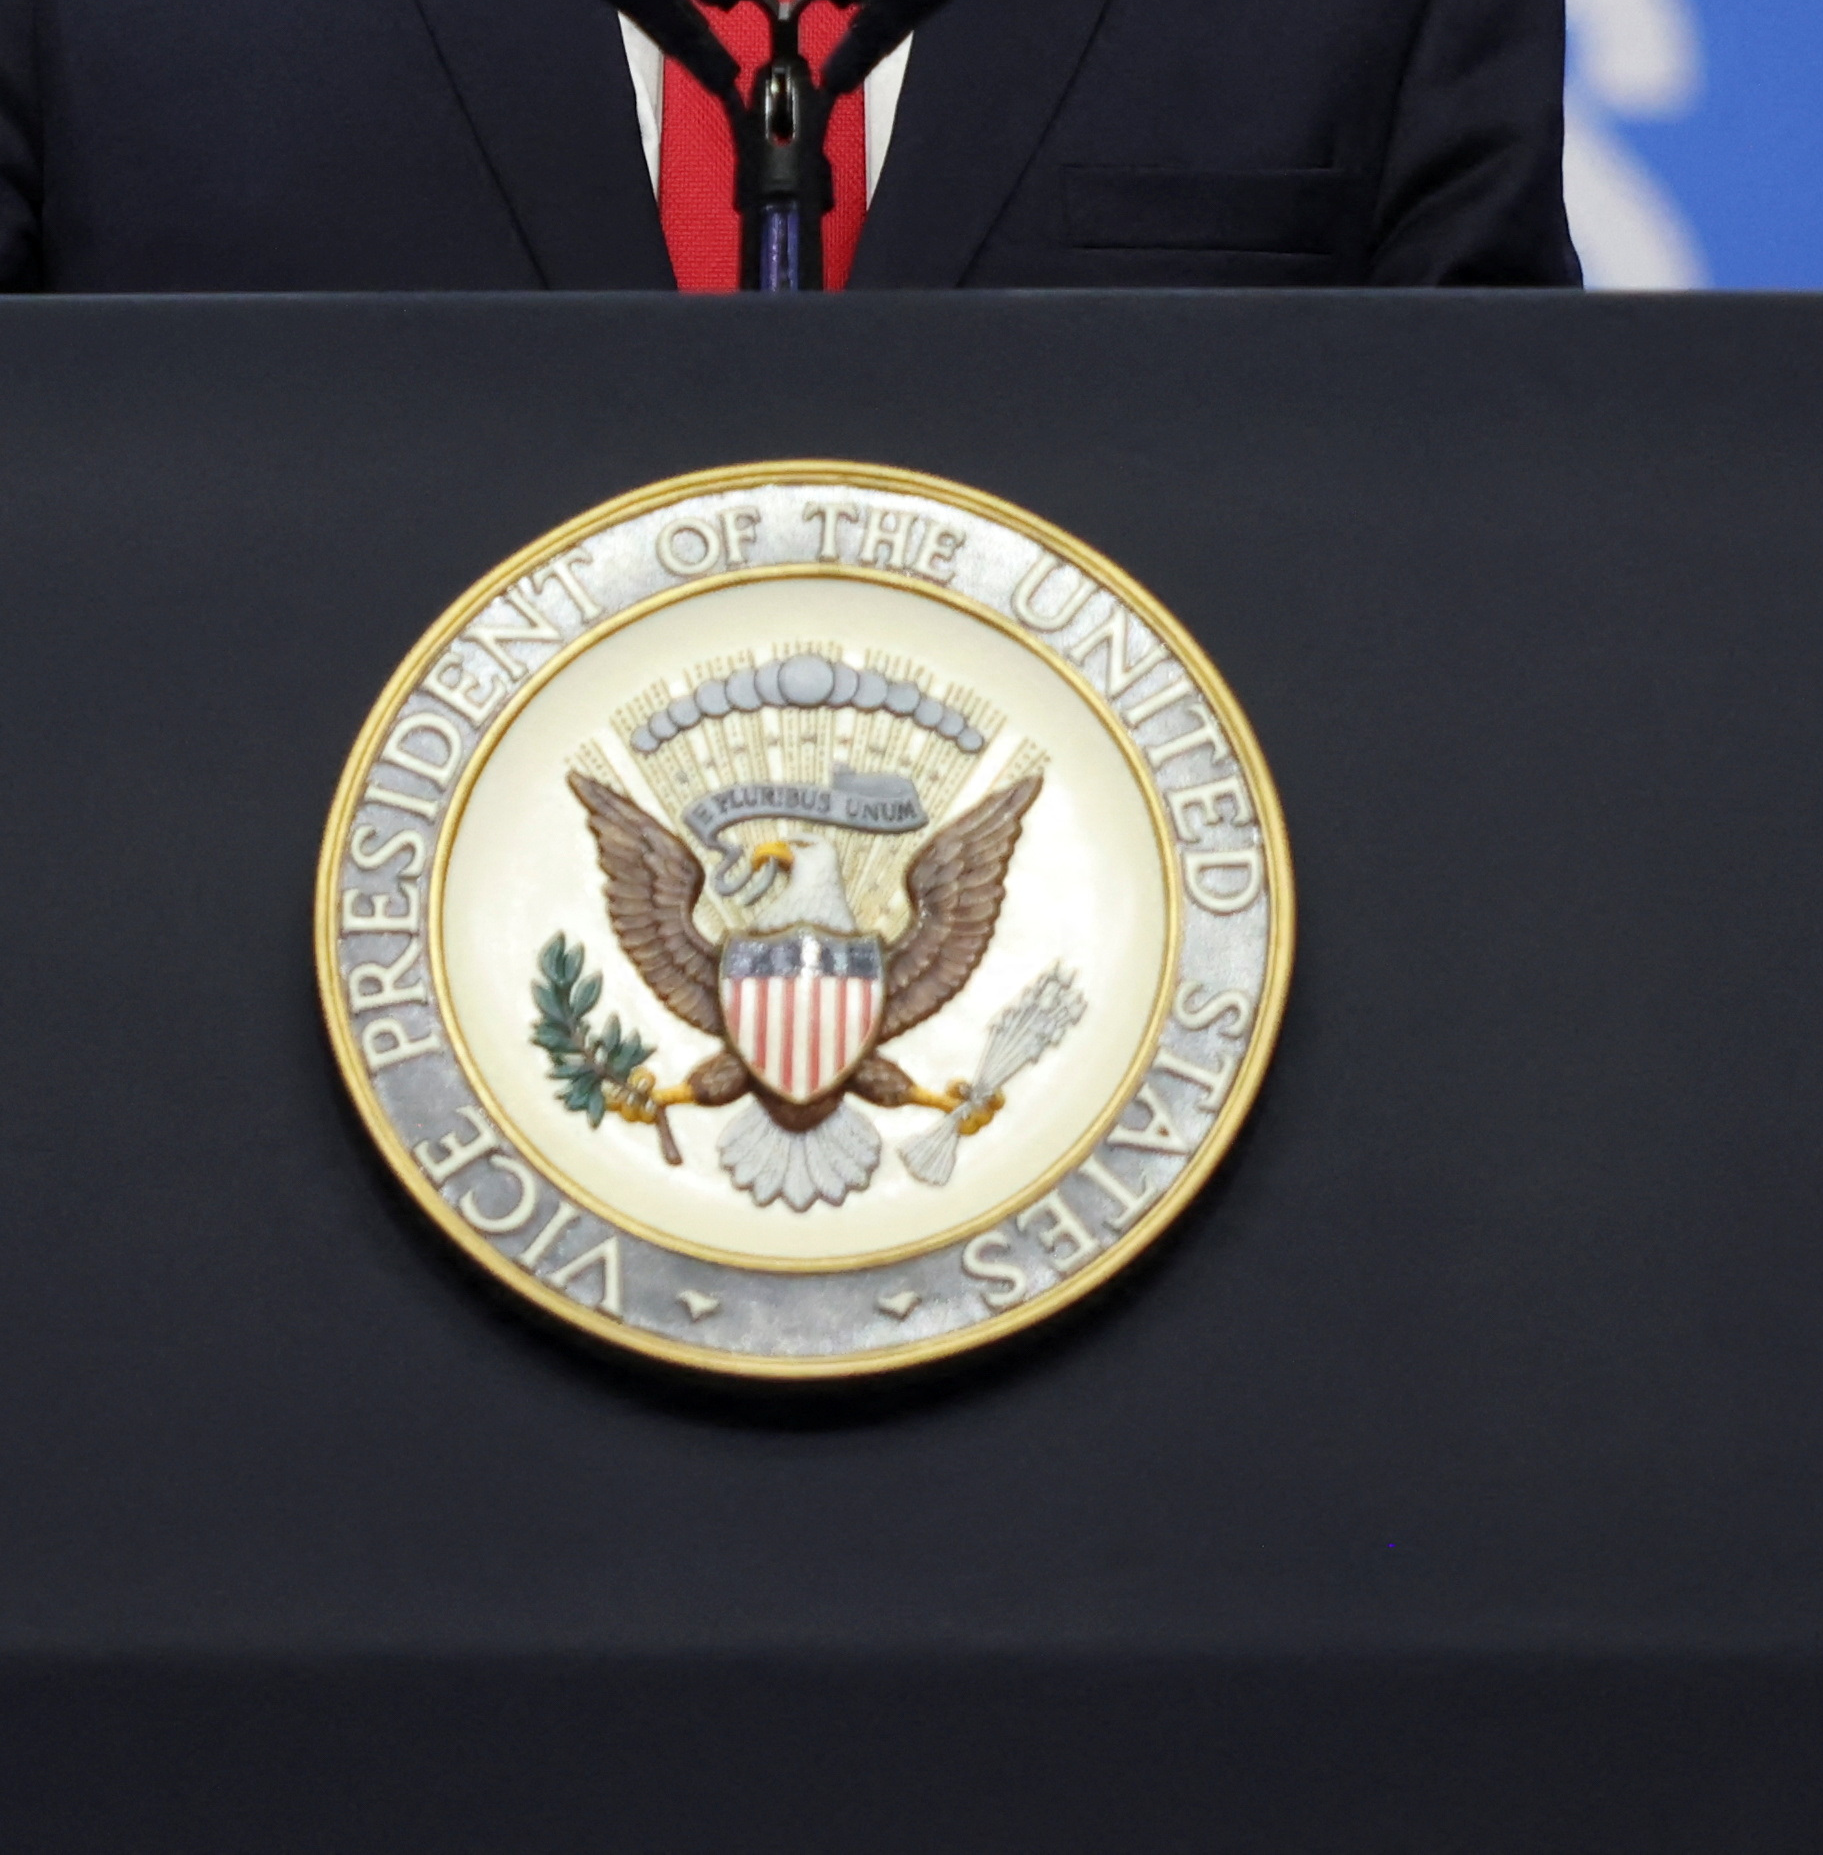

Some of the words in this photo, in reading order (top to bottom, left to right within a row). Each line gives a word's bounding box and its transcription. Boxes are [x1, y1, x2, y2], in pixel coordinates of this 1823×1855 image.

[656, 504, 761, 576] OF
[802, 500, 967, 587] THE
[342, 546, 604, 1068] PRESIDENT
[691, 802, 714, 826] E
[712, 786, 832, 815] PLURIBUS
[845, 797, 917, 822] UNUM
[1010, 551, 1262, 914] UNITED
[413, 1104, 622, 1318] VICE
[962, 980, 1251, 1312] STATES
